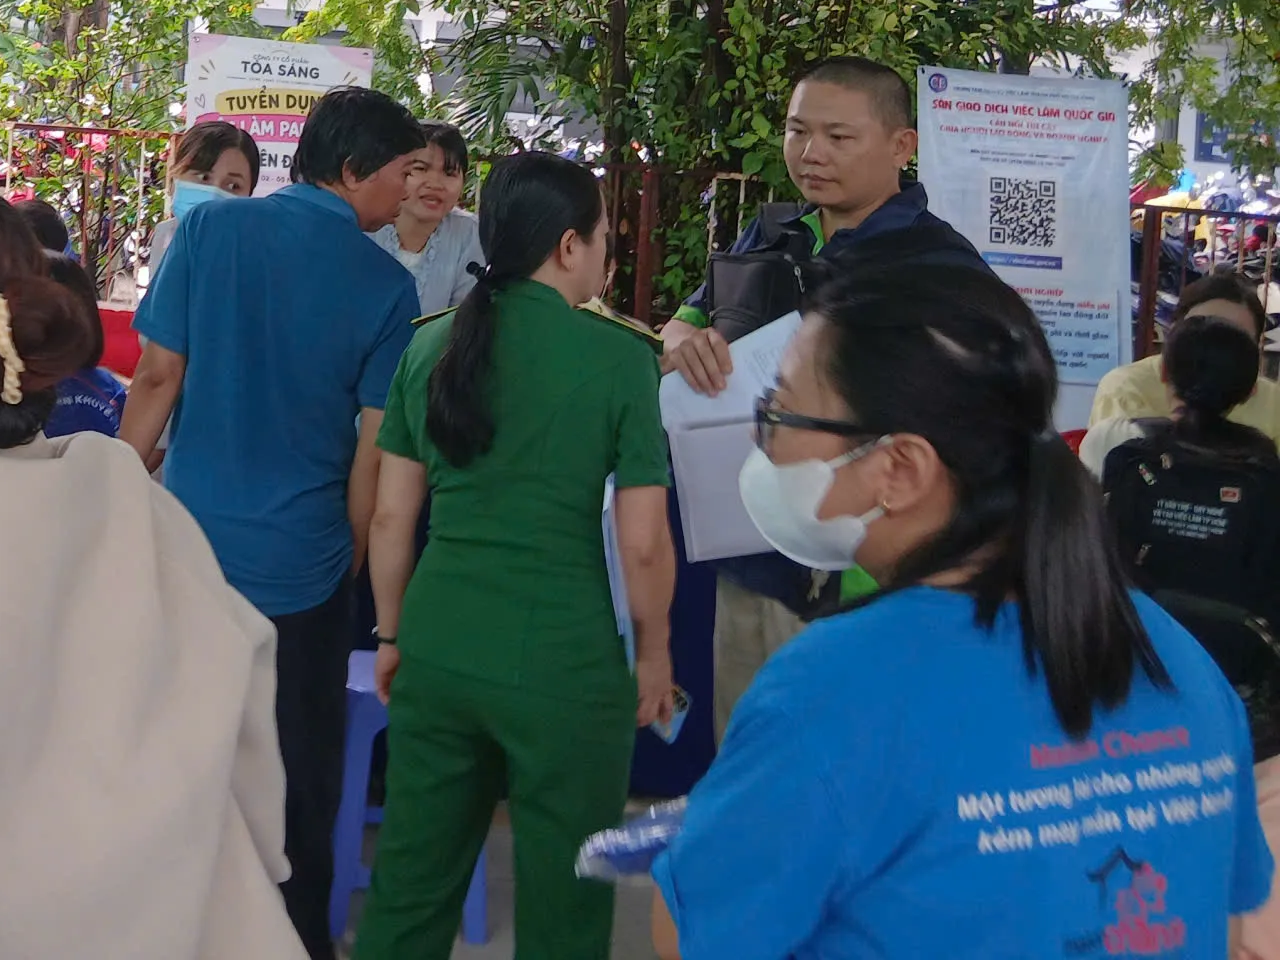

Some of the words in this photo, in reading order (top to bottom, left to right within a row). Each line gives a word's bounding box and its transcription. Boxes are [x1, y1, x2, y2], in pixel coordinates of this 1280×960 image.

[278, 62, 320, 80] SÁNG
[226, 85, 280, 111] TUYỂN
[286, 94, 320, 114] DỤN
